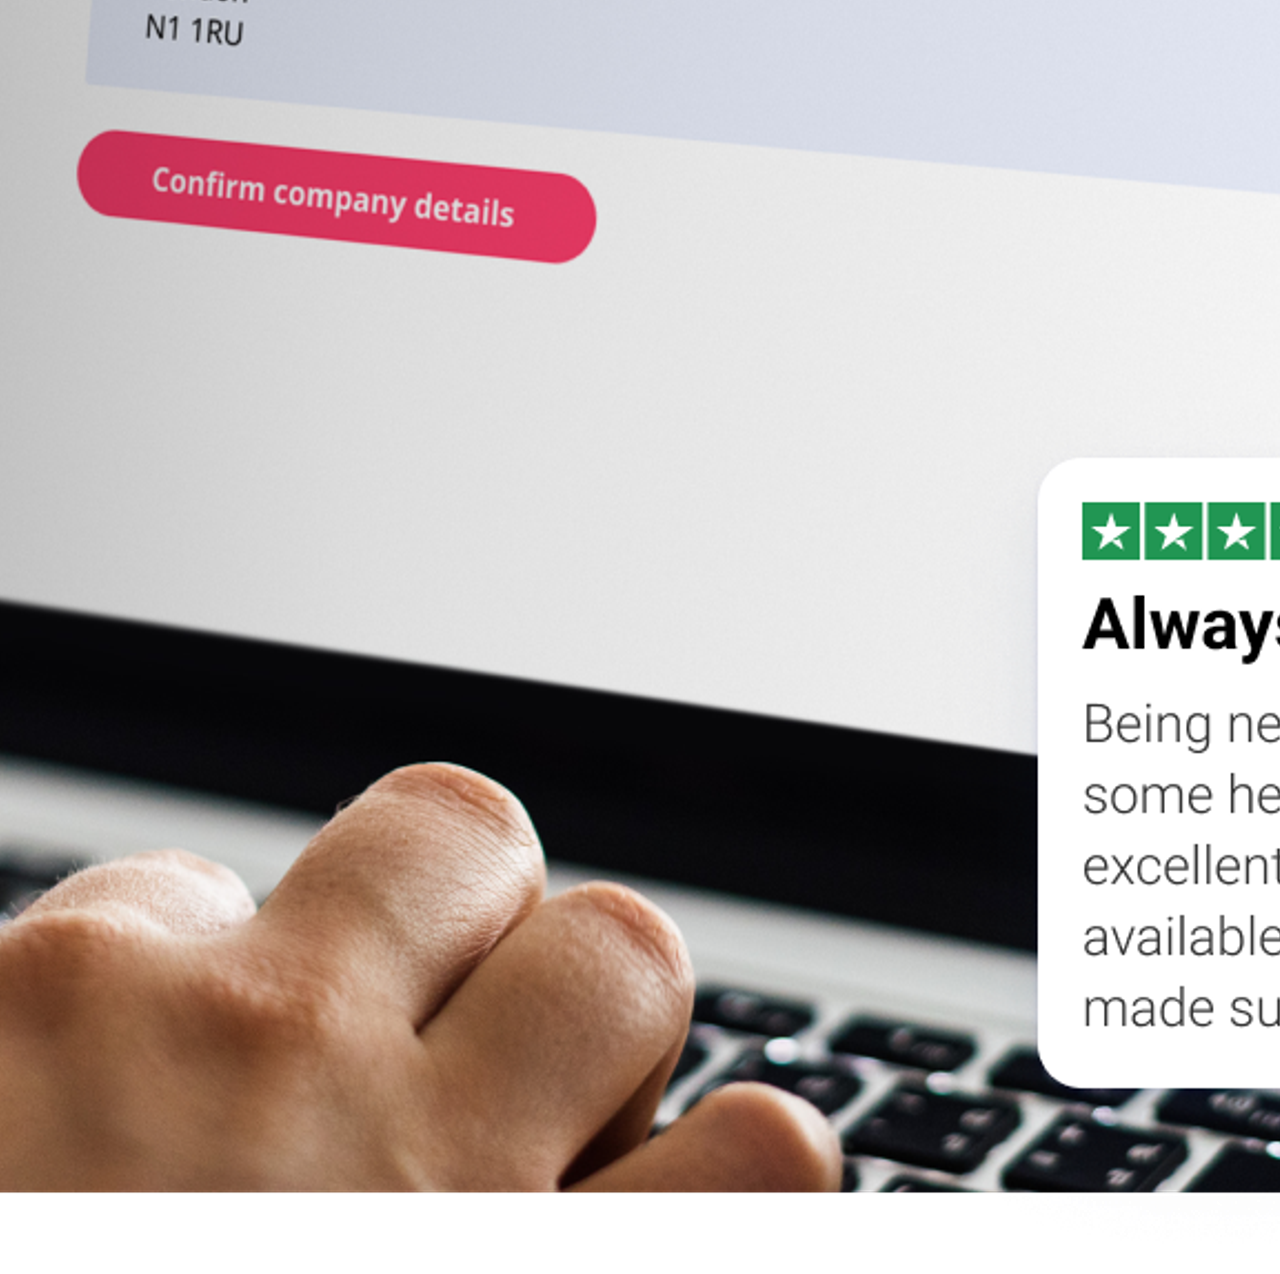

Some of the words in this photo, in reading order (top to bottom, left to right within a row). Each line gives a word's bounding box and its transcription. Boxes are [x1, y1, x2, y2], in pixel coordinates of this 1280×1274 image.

[145, 12, 179, 42] N1
[192, 16, 244, 48] 1RU
[152, 165, 265, 203] Confirm
[273, 183, 408, 224] company
[414, 191, 515, 229] details
